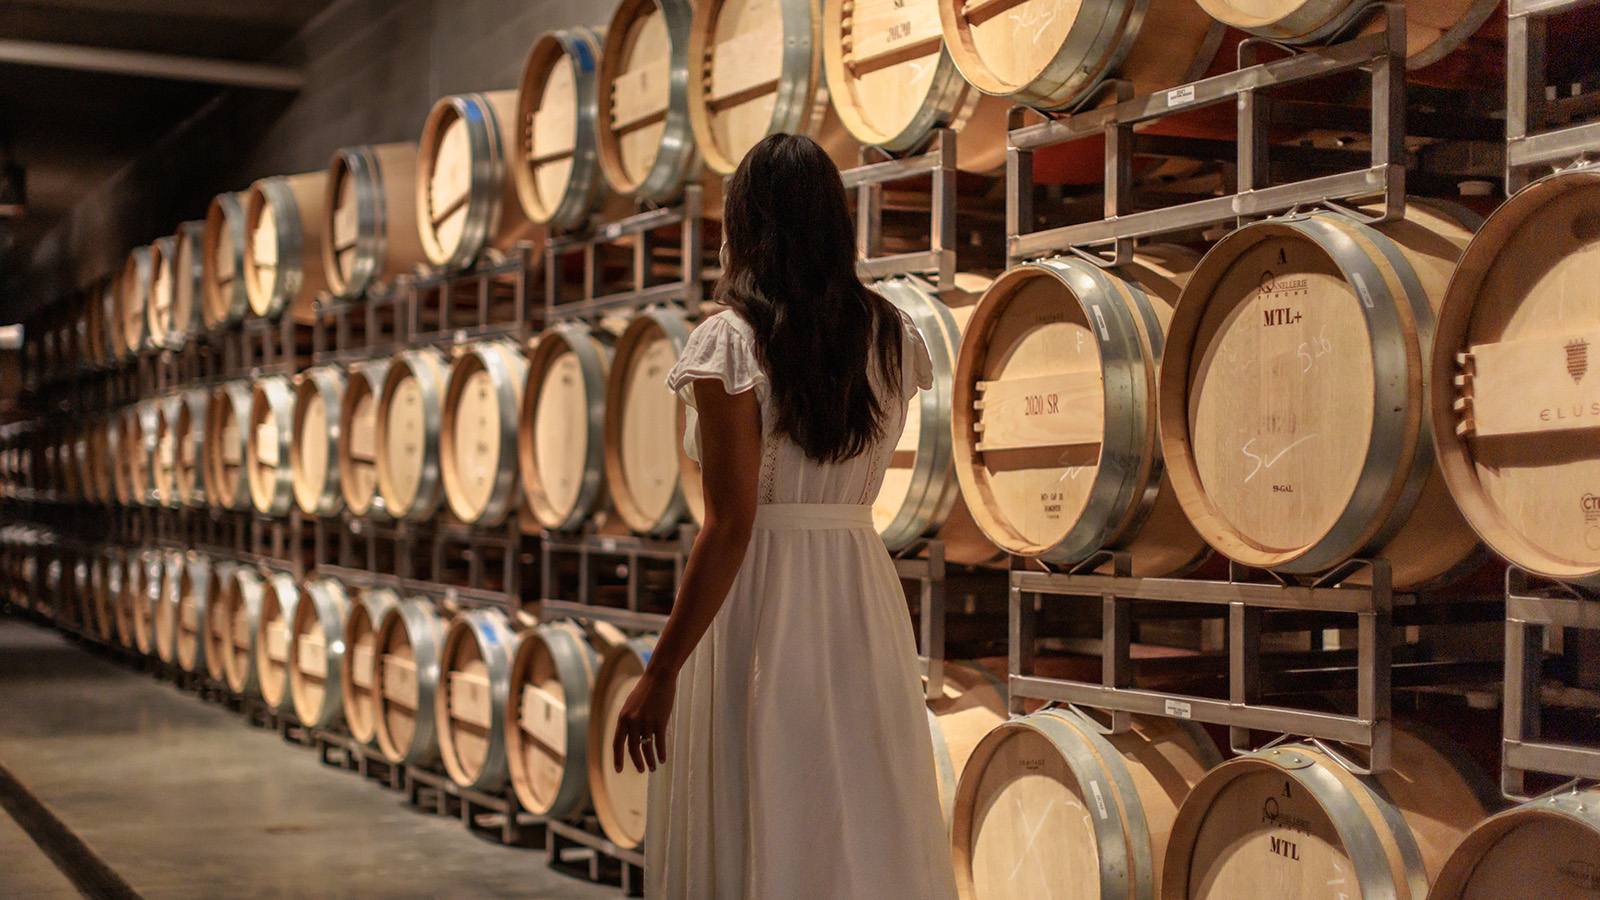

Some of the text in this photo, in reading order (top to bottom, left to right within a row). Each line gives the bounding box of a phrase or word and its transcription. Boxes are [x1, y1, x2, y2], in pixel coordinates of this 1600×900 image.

[1277, 247, 1287, 265] A
[1263, 307, 1303, 327] MTL+
[1025, 394, 1059, 416] 2020 SR
[1281, 781, 1291, 798] A
[1270, 836, 1300, 861] MTL
